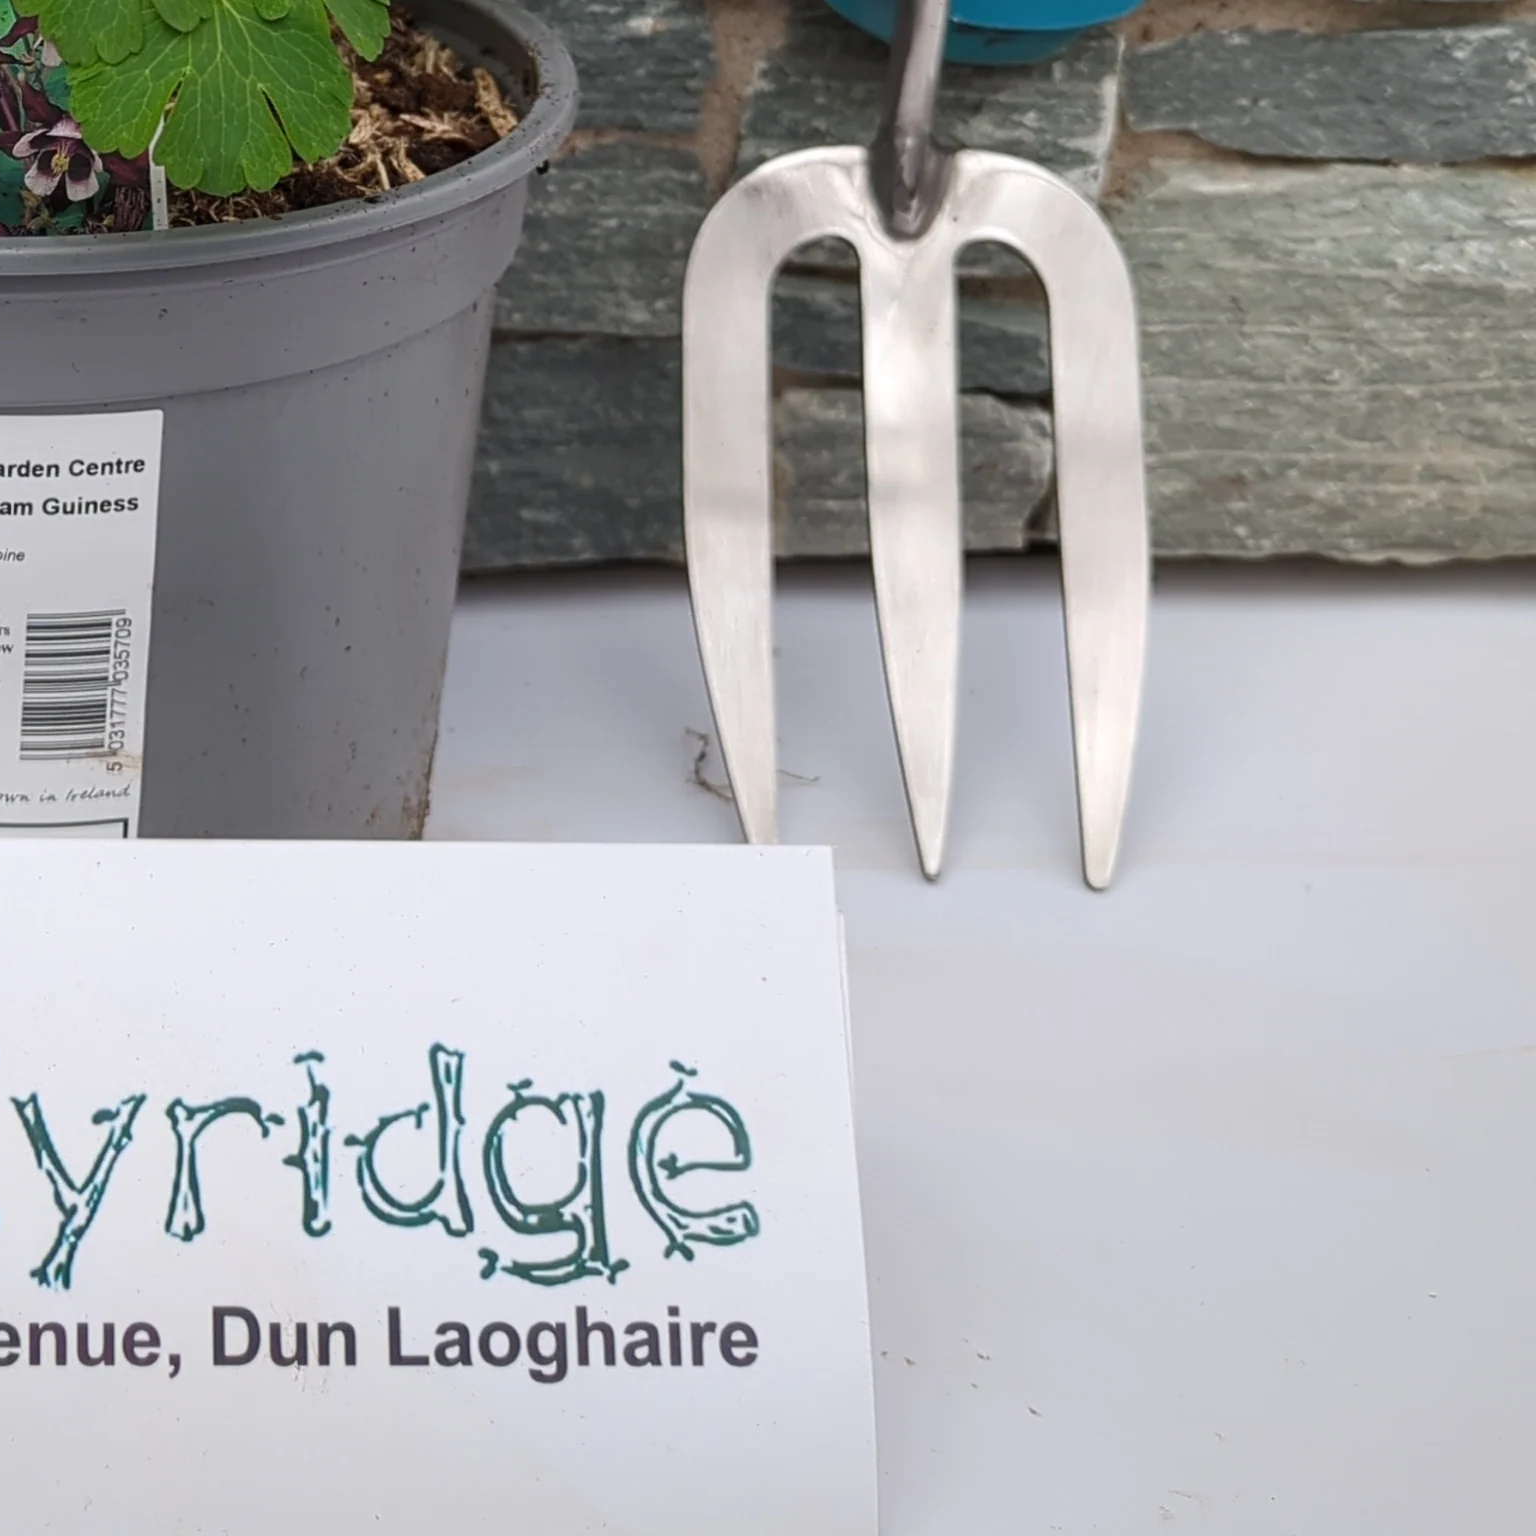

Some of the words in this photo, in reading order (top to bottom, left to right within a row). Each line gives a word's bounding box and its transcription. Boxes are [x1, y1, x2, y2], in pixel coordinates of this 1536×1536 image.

[68, 456, 147, 477] Centre
[41, 496, 140, 516] Guiness
[39, 787, 57, 801] in
[65, 783, 133, 802] Ireland
[212, 1305, 357, 1368] Dun
[387, 1305, 759, 1385] Laoghaire
